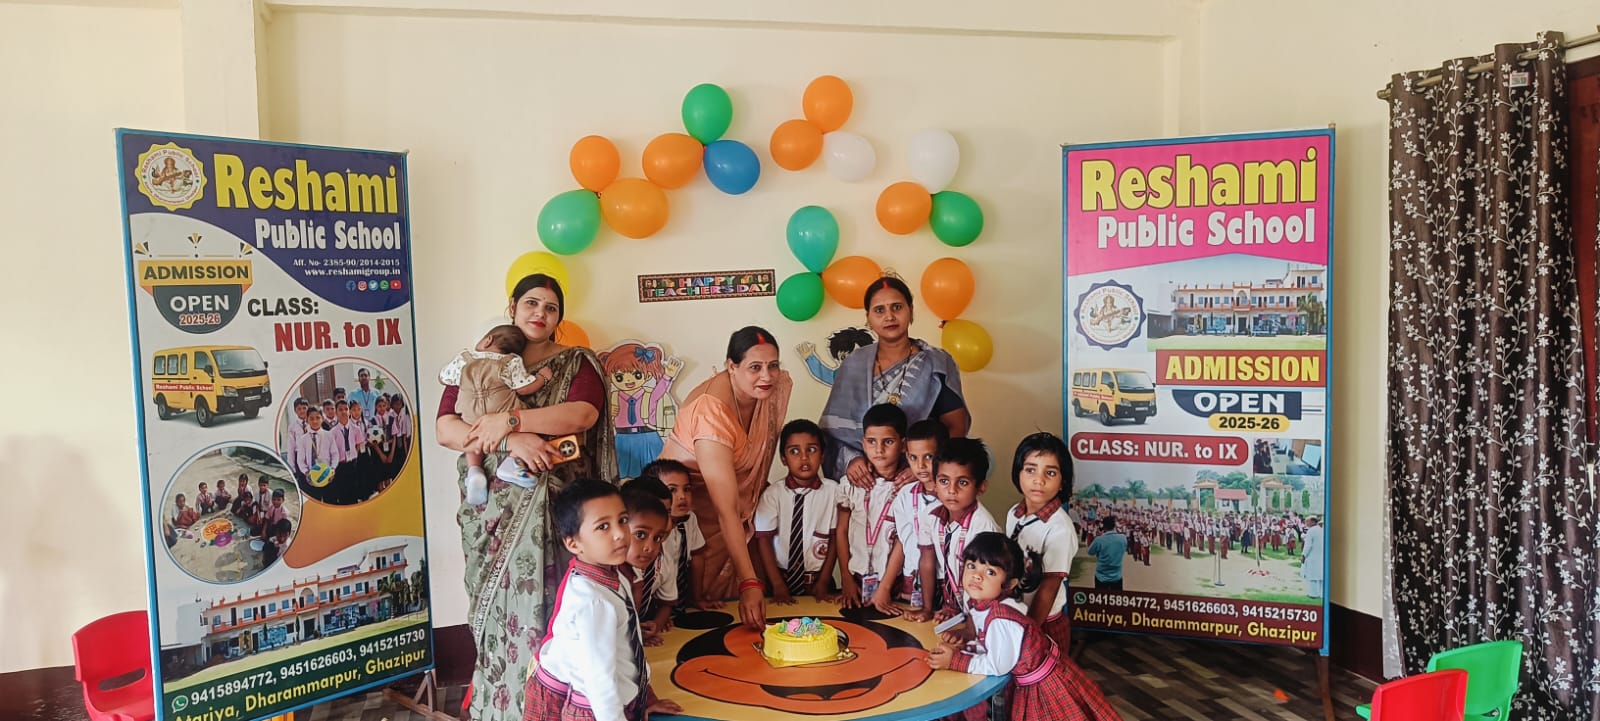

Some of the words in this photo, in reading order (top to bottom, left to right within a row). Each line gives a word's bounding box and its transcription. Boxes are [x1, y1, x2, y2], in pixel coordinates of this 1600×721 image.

[213, 153, 398, 214] Reshami
[1081, 147, 1317, 211] Reshami
[255, 218, 326, 249] Public
[334, 219, 401, 250] School
[1098, 213, 1194, 249] Public
[1207, 208, 1315, 246] School
[144, 265, 249, 280] ADMISSION
[304, 267, 401, 277] www.reshamigroup.in
[678, 275, 736, 288] HAPPY
[737, 283, 770, 293] DAY
[170, 295, 229, 312] OPEN
[248, 297, 319, 317] CLASS:
[179, 314, 220, 326] 2025-26
[274, 321, 338, 352] NUR.
[344, 322, 370, 348] to
[377, 318, 402, 346] IX
[1165, 355, 1319, 382] ADMISSION
[1193, 392, 1285, 413] OPEN
[1218, 416, 1280, 430] 2025-26
[1077, 438, 1139, 455] CLASS:
[1145, 441, 1189, 458] NUR.
[1195, 443, 1212, 459] to
[1219, 443, 1238, 460] IX
[1088, 593, 1160, 611] 9415894772,
[1163, 598, 1239, 617] 9451626603,
[1242, 604, 1318, 623] 9415215730
[1073, 607, 1127, 627] Atariya,
[1131, 612, 1243, 637] Dharammarpur,
[1247, 622, 1317, 643] Ghazipur
[191, 670, 277, 705] 9415894772,
[280, 649, 357, 678] 9451626603,
[359, 628, 425, 657] 9415215730
[246, 667, 361, 712] Dharammarpur,
[365, 648, 426, 676] Ghazipur
